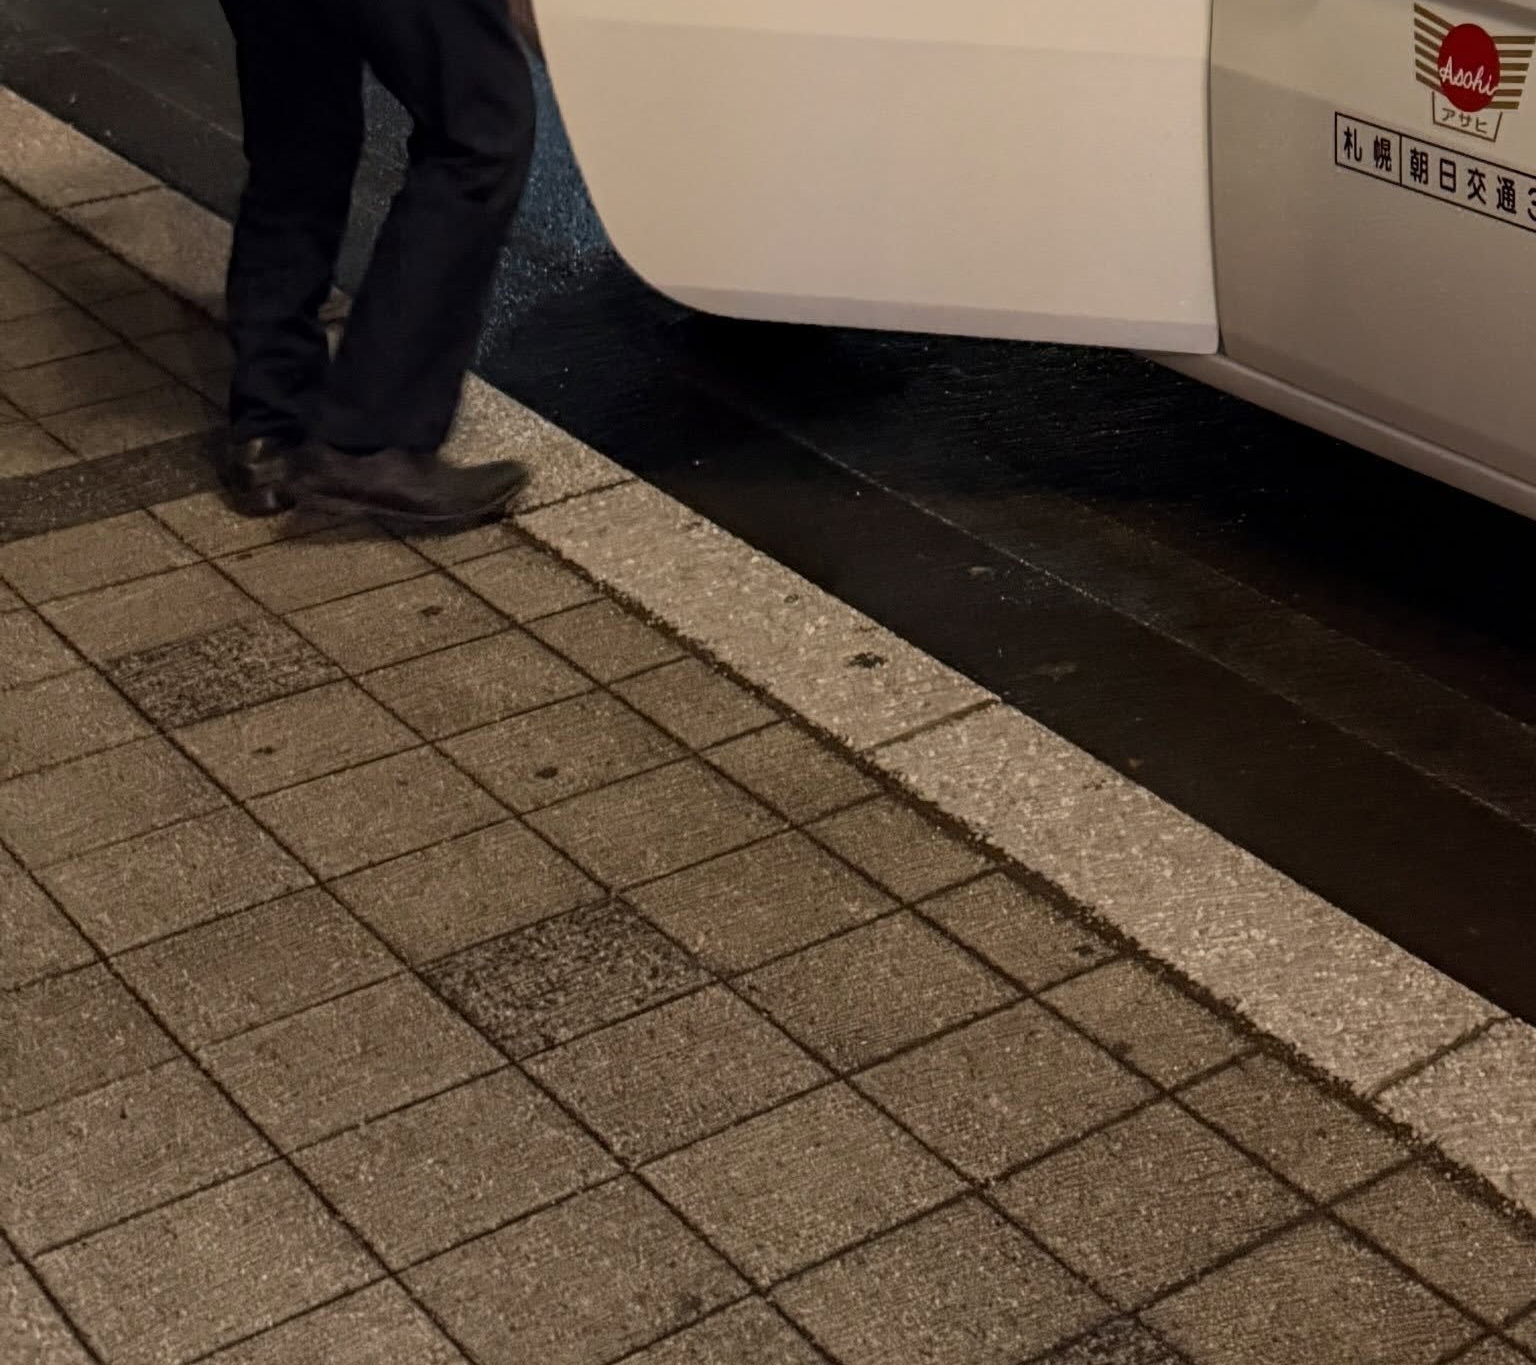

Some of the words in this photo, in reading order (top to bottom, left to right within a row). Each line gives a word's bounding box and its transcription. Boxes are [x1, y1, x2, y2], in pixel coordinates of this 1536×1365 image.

[1439, 56, 1500, 97] Asahi
[1442, 107, 1489, 135] アサヒ
[1343, 128, 1393, 173] 札幌
